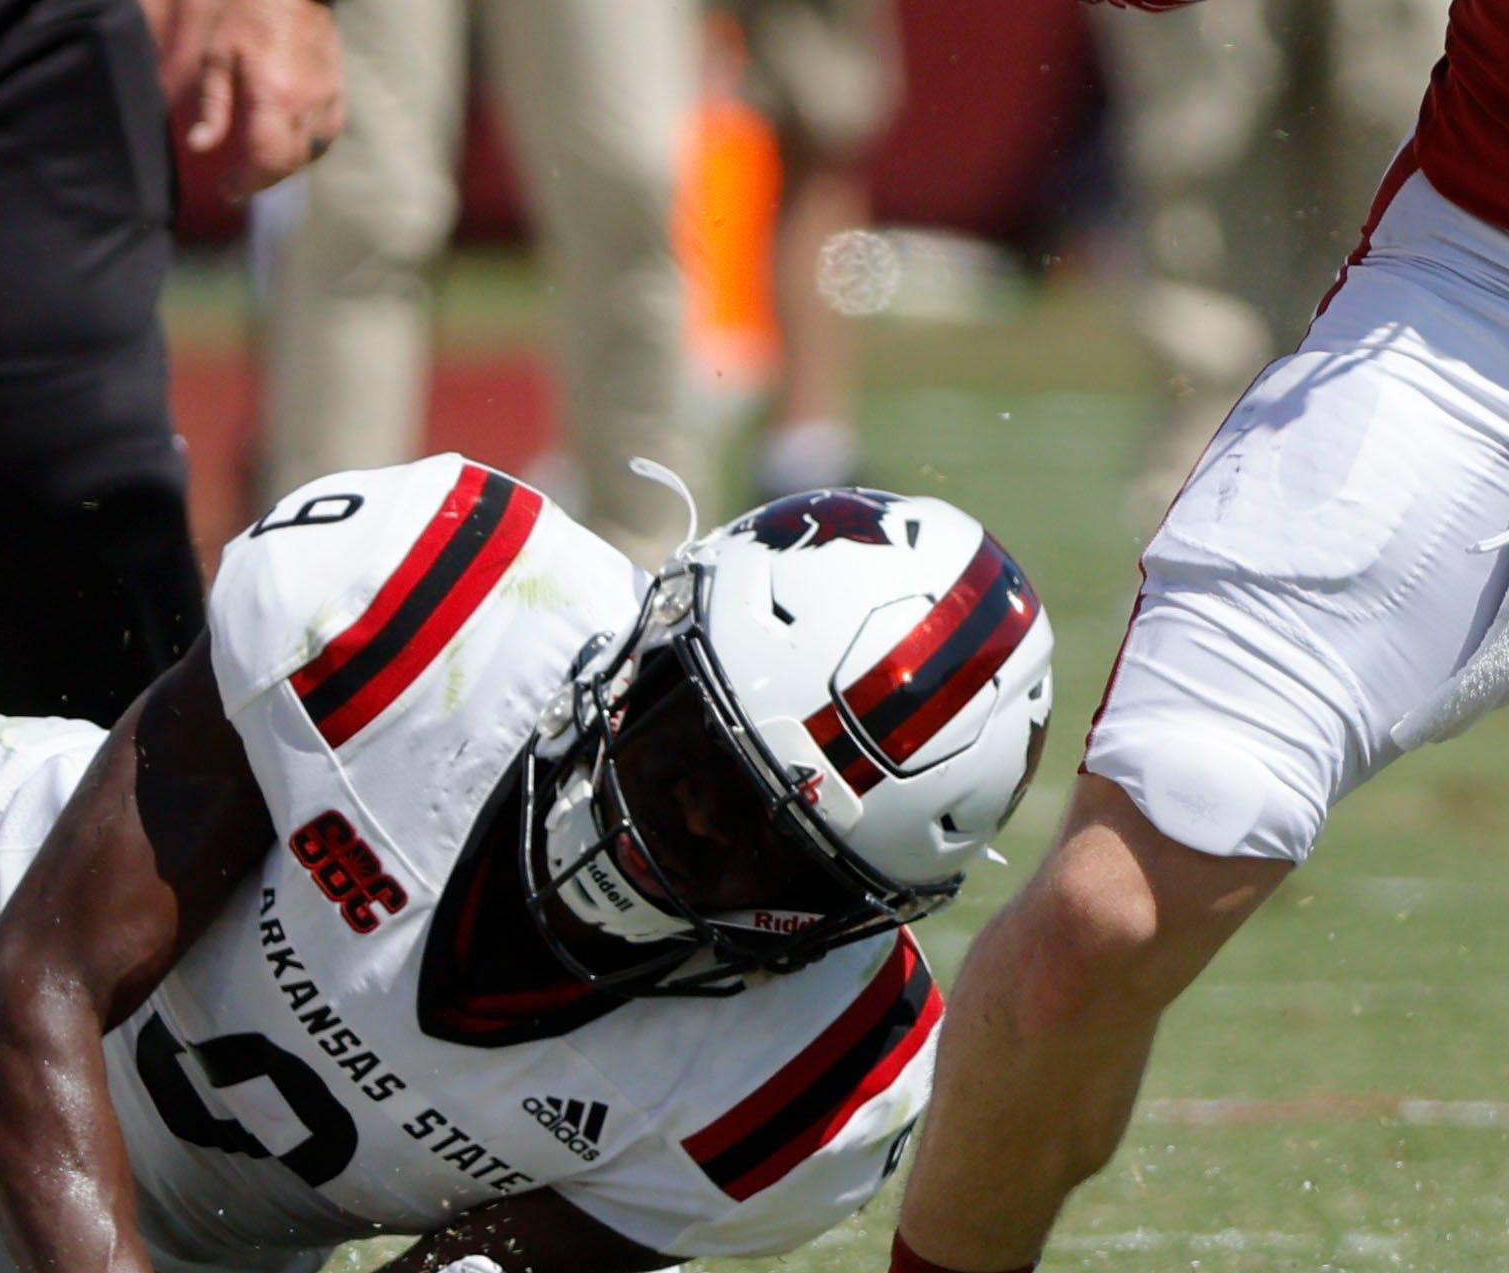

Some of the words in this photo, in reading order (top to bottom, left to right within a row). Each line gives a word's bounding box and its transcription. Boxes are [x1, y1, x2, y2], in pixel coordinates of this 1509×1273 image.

[586, 861, 634, 913] iddell
[259, 886, 408, 1103] ARKANSAS
[401, 1107, 535, 1195] STATE
[520, 1095, 601, 1164] adidas
